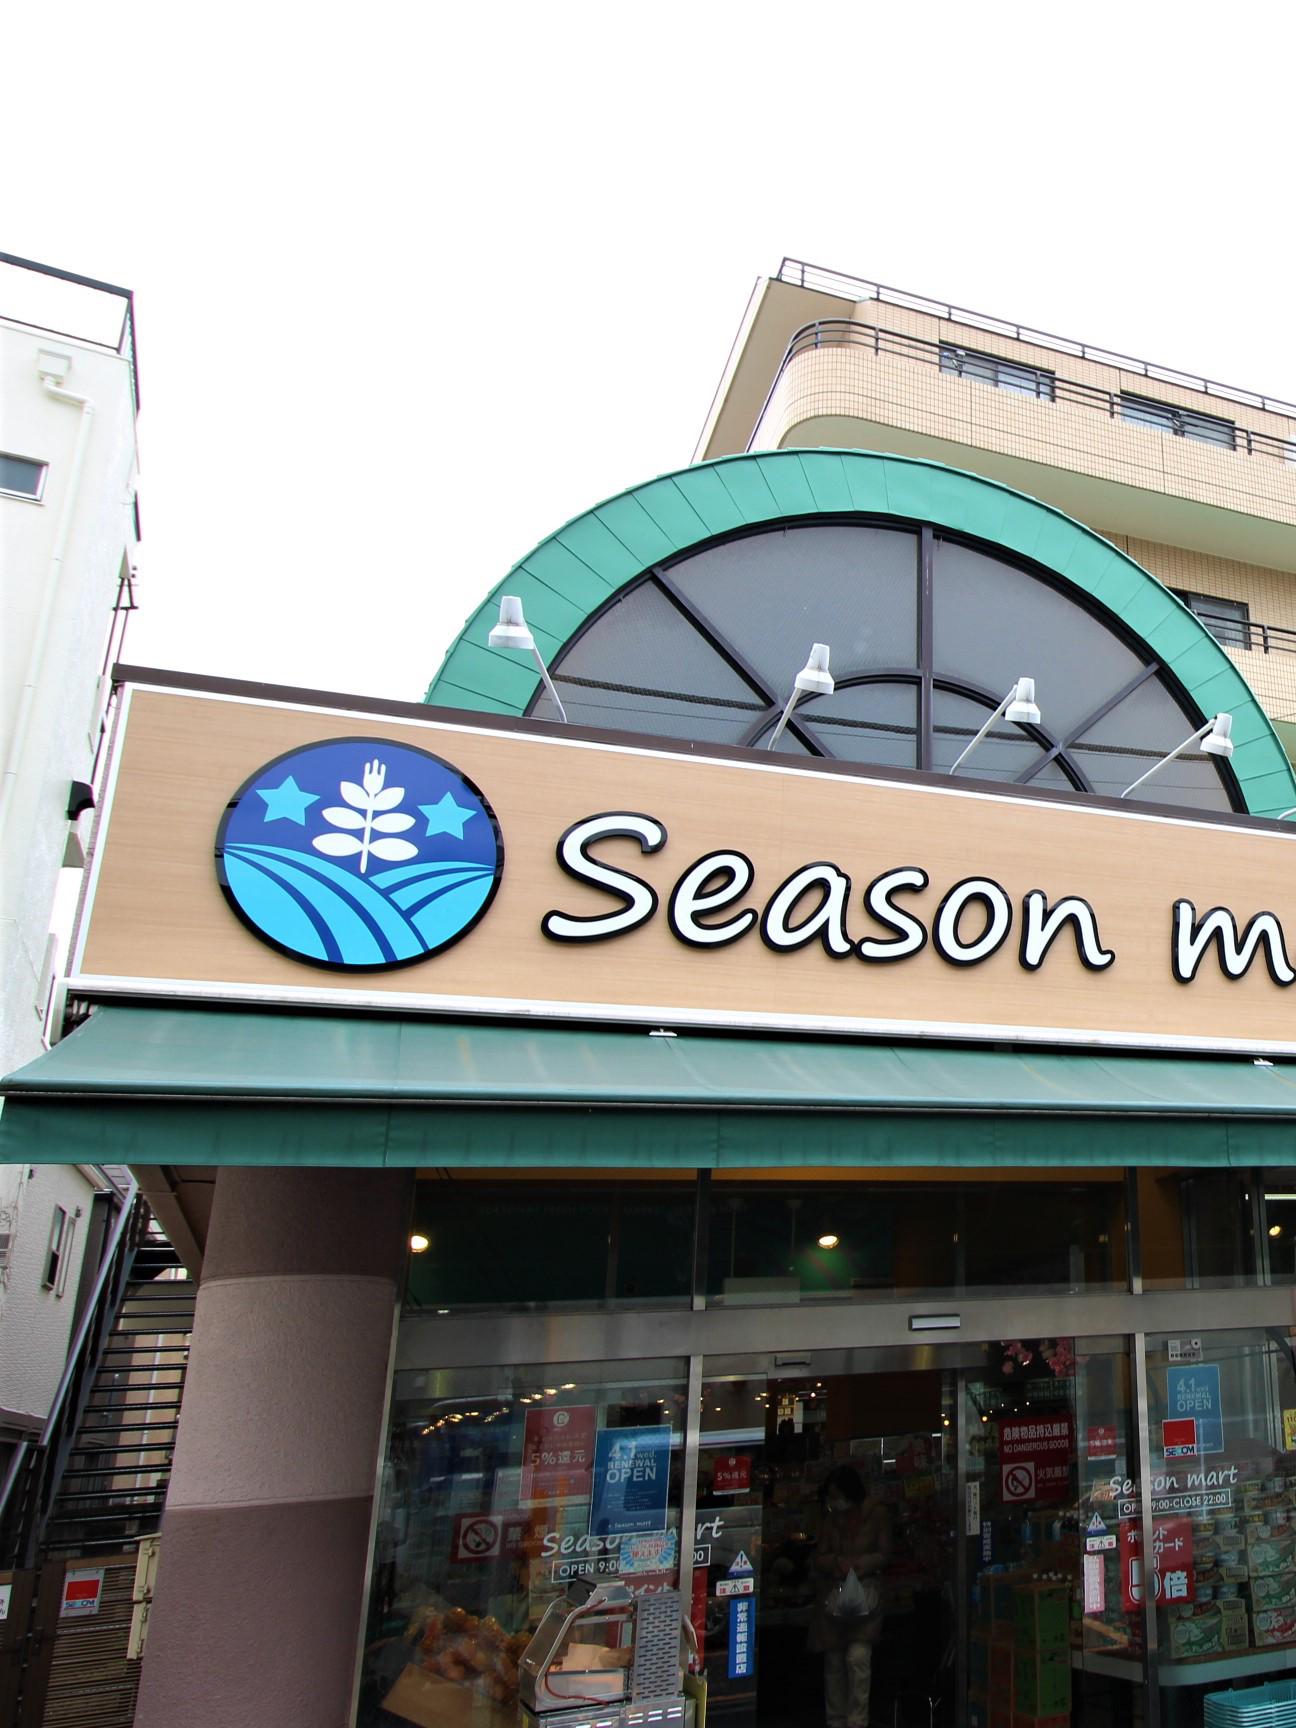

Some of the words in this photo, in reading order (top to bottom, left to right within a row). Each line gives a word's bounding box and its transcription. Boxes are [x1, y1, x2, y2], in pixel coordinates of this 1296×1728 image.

[541, 810, 1115, 971] Season
[1177, 1400, 1212, 1412] OPEN
[608, 1440, 637, 1459] 4.1
[1004, 1443, 1013, 1453] NO
[1013, 1441, 1049, 1452] DANGEROUS
[1165, 1445, 1195, 1456] SECOM
[530, 1450, 586, 1466] 5%還元
[607, 1458, 657, 1470] RENEWAL
[606, 1467, 657, 1484] OPEN
[1187, 1465, 1239, 1489] mart
[1203, 1494, 1226, 1504] 22:00
[1153, 1536, 1184, 1553] カード
[559, 1562, 595, 1577] OPEN
